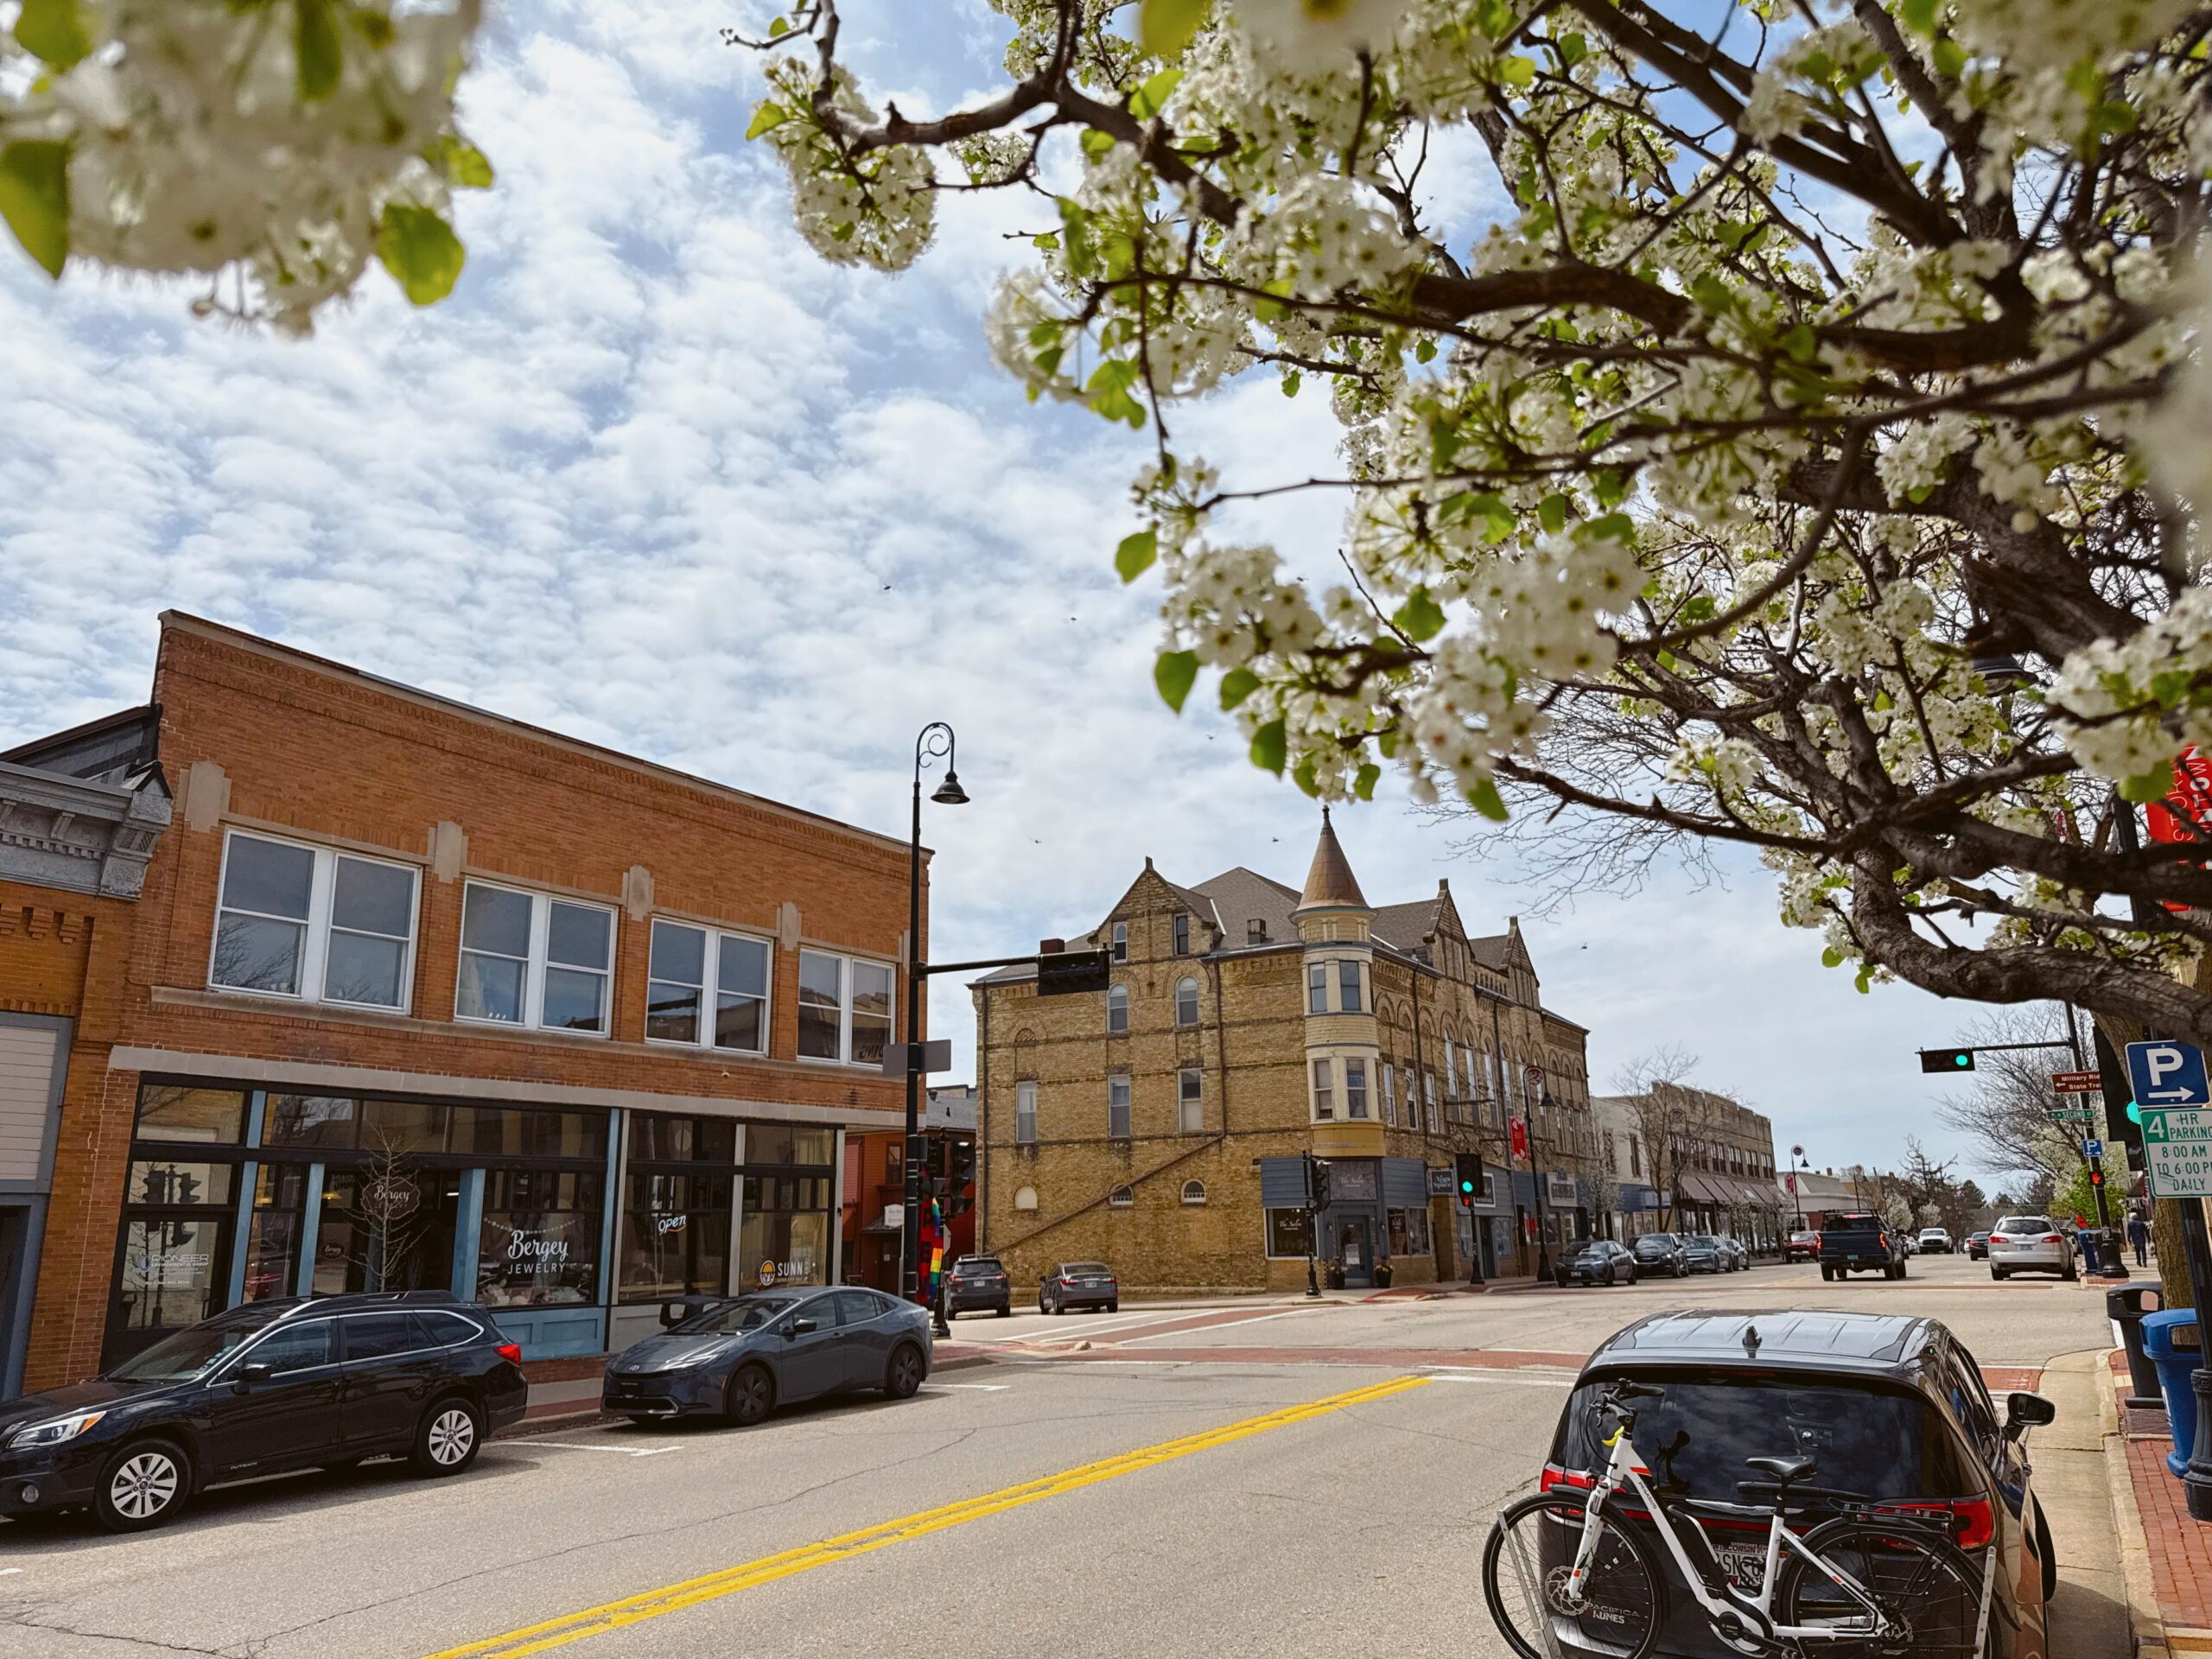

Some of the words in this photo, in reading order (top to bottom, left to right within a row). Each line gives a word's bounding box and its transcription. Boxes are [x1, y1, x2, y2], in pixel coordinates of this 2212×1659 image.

[2146, 1048, 2183, 1086] P
[2179, 1113, 2198, 1125] HR
[2147, 1116, 2164, 1139] 4
[2086, 1141, 2097, 1151] P
[2162, 1146, 2188, 1159] 8:00
[2191, 1145, 2207, 1158] AM
[2156, 1163, 2170, 1173] TO
[2175, 1162, 2200, 1175] 6:00
[2203, 1162, 2212, 1173] P
[1433, 1181, 1452, 1190] Space
[1435, 1174, 1451, 1184] Yoga
[2173, 1179, 2206, 1192] DAILY
[507, 1230, 569, 1262] Bergey
[151, 1254, 209, 1262] PIONEER
[507, 1262, 565, 1274] JEWELRY
[778, 1262, 803, 1276] SUNN
[1713, 1544, 1756, 1554] WISCONSIN
[1586, 1603, 1640, 1617] PACIFICA
[1592, 1609, 1625, 1624] KUNES
